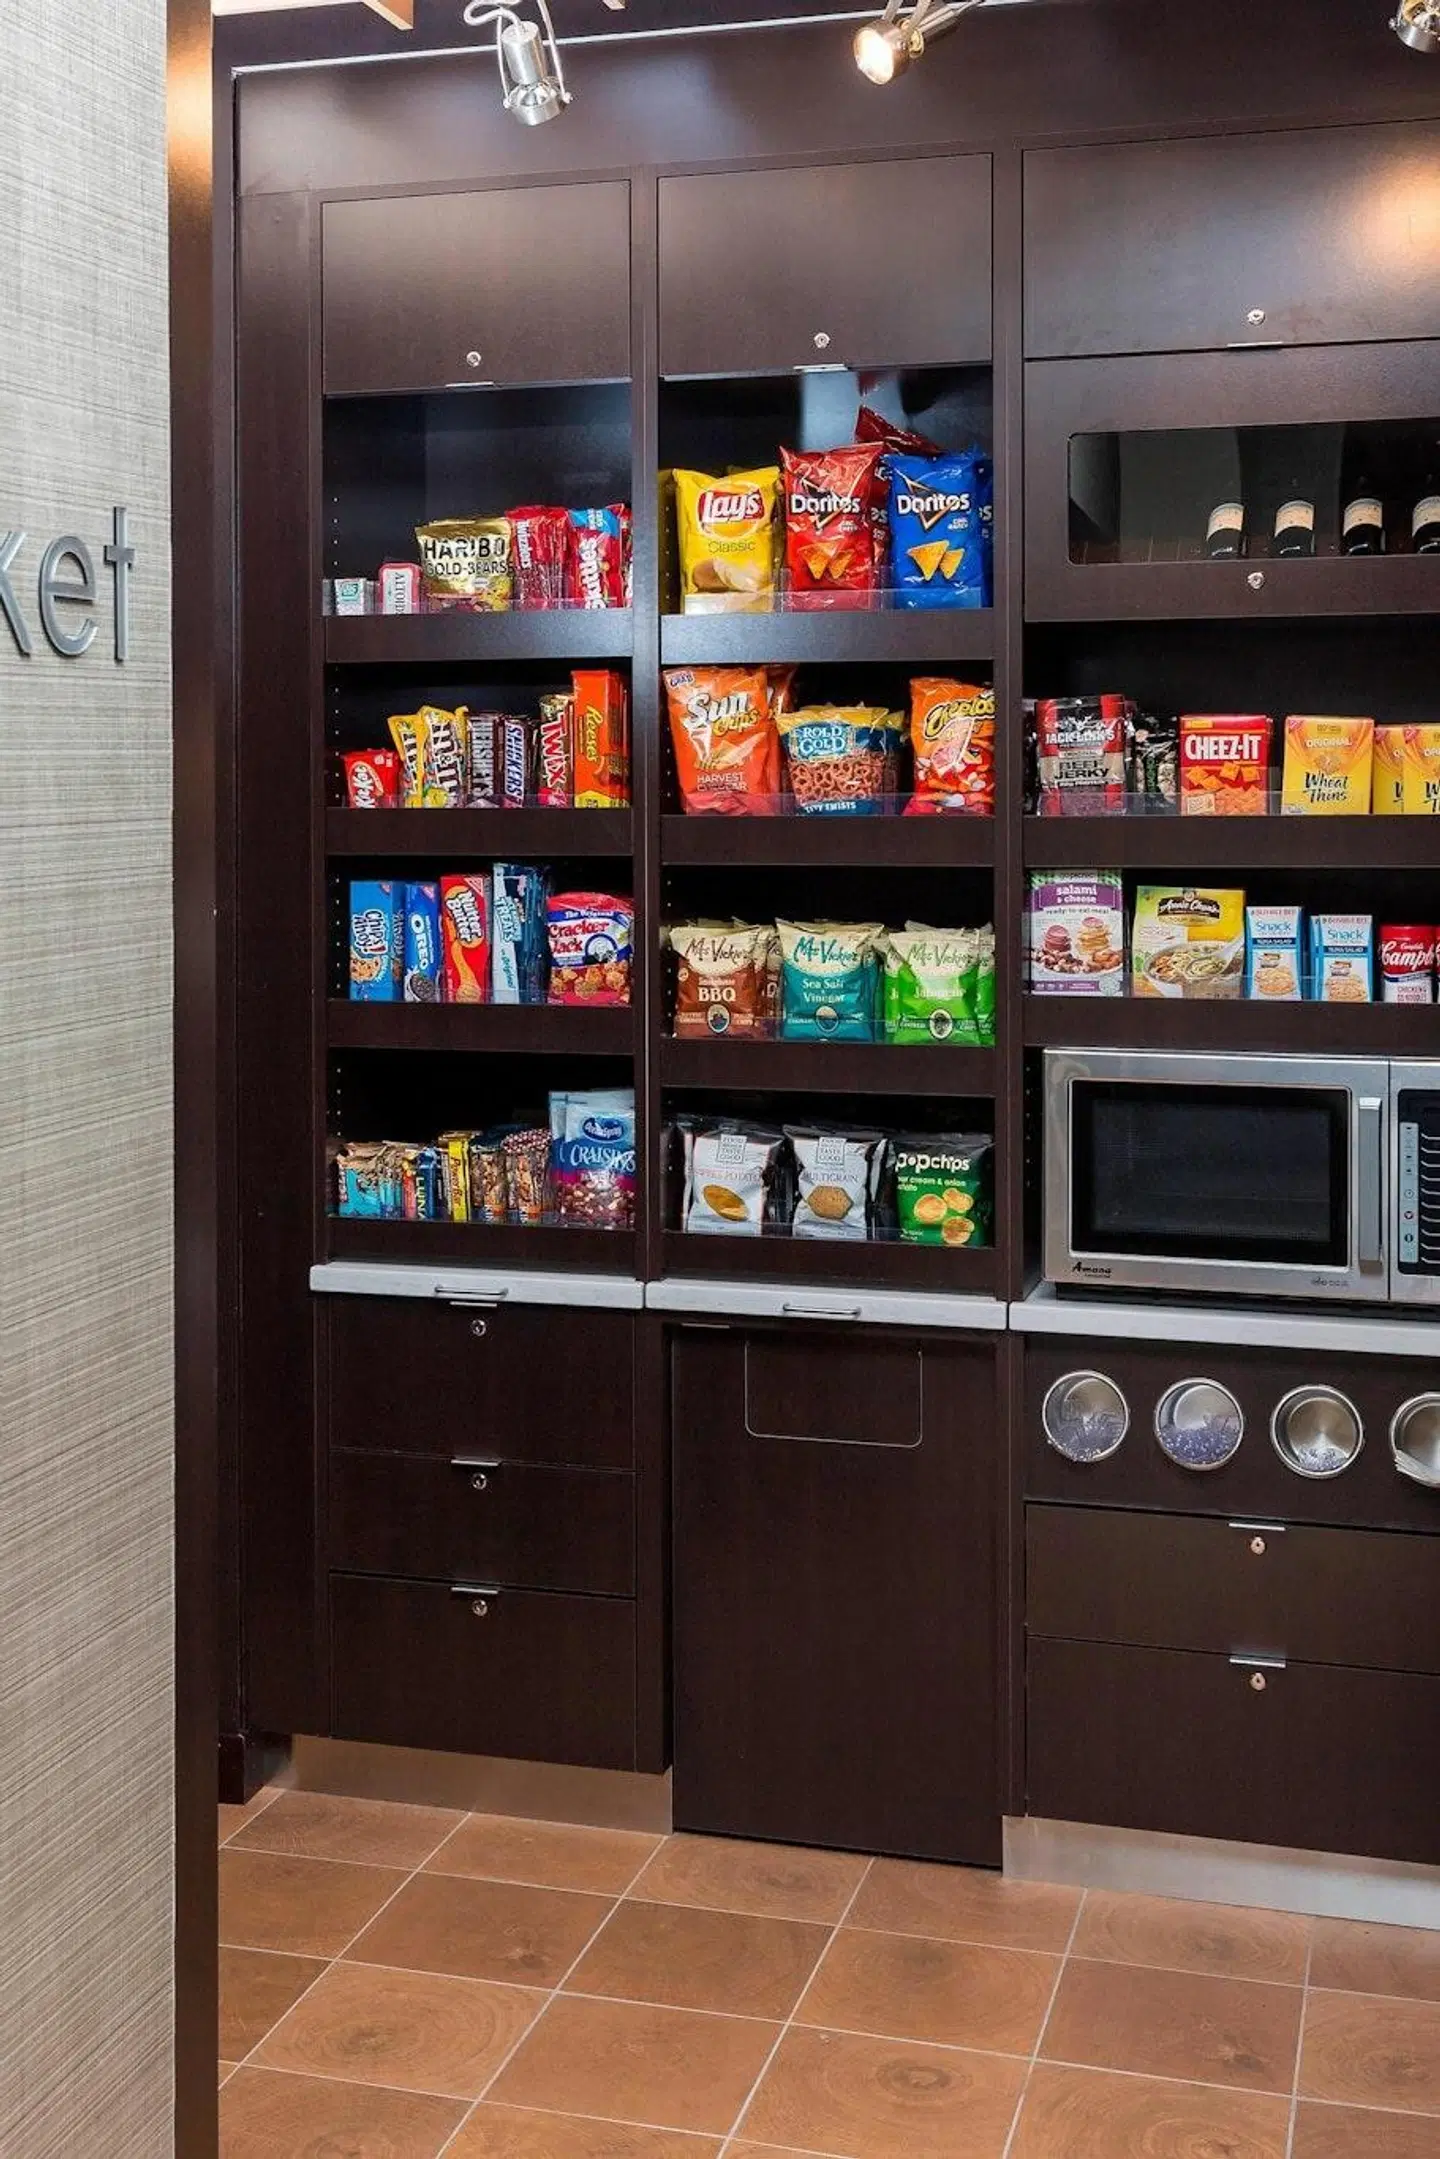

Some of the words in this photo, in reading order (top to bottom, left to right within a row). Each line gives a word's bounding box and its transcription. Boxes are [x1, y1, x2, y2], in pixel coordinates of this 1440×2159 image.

[701, 488, 761, 523] Lay's
[791, 493, 861, 514] Doritos
[897, 492, 971, 514] Doritos
[423, 537, 506, 560] HARIBO
[517, 519, 533, 569] Twizzlers
[708, 540, 756, 554] Classic
[683, 692, 748, 729] Sun
[925, 695, 995, 738] Cheetos
[711, 708, 759, 736] Chips
[803, 725, 842, 738] ROLD
[586, 704, 603, 762] Reese's
[800, 735, 846, 752] GOLD
[1305, 738, 1352, 748] ORIGINAL
[541, 712, 567, 788] TWIX
[1185, 733, 1262, 760] CHEEZ-IT
[472, 721, 494, 797] HERSHEY'S
[506, 722, 524, 798] SNICKERS
[696, 771, 744, 784] HARVEST
[1054, 768, 1110, 780] JERKY
[1305, 772, 1348, 789] Wheat
[1303, 788, 1347, 803] Thins
[1056, 885, 1097, 896] salami
[1064, 894, 1097, 904] cheese
[446, 899, 474, 942] Butter
[458, 890, 482, 937] Nutter
[494, 898, 514, 943] TREATS
[565, 911, 579, 919] The
[363, 910, 384, 946] Chips
[548, 919, 610, 938] Cracker
[1256, 920, 1292, 932] Snack
[1327, 928, 1364, 940] Snack
[411, 914, 429, 970] OREO
[552, 939, 583, 955] Jack
[697, 985, 737, 1003] BBQ
[802, 979, 821, 989] Sea
[823, 978, 845, 990] Salt
[802, 992, 845, 1004] Vinegar
[895, 1152, 971, 1174] popchips
